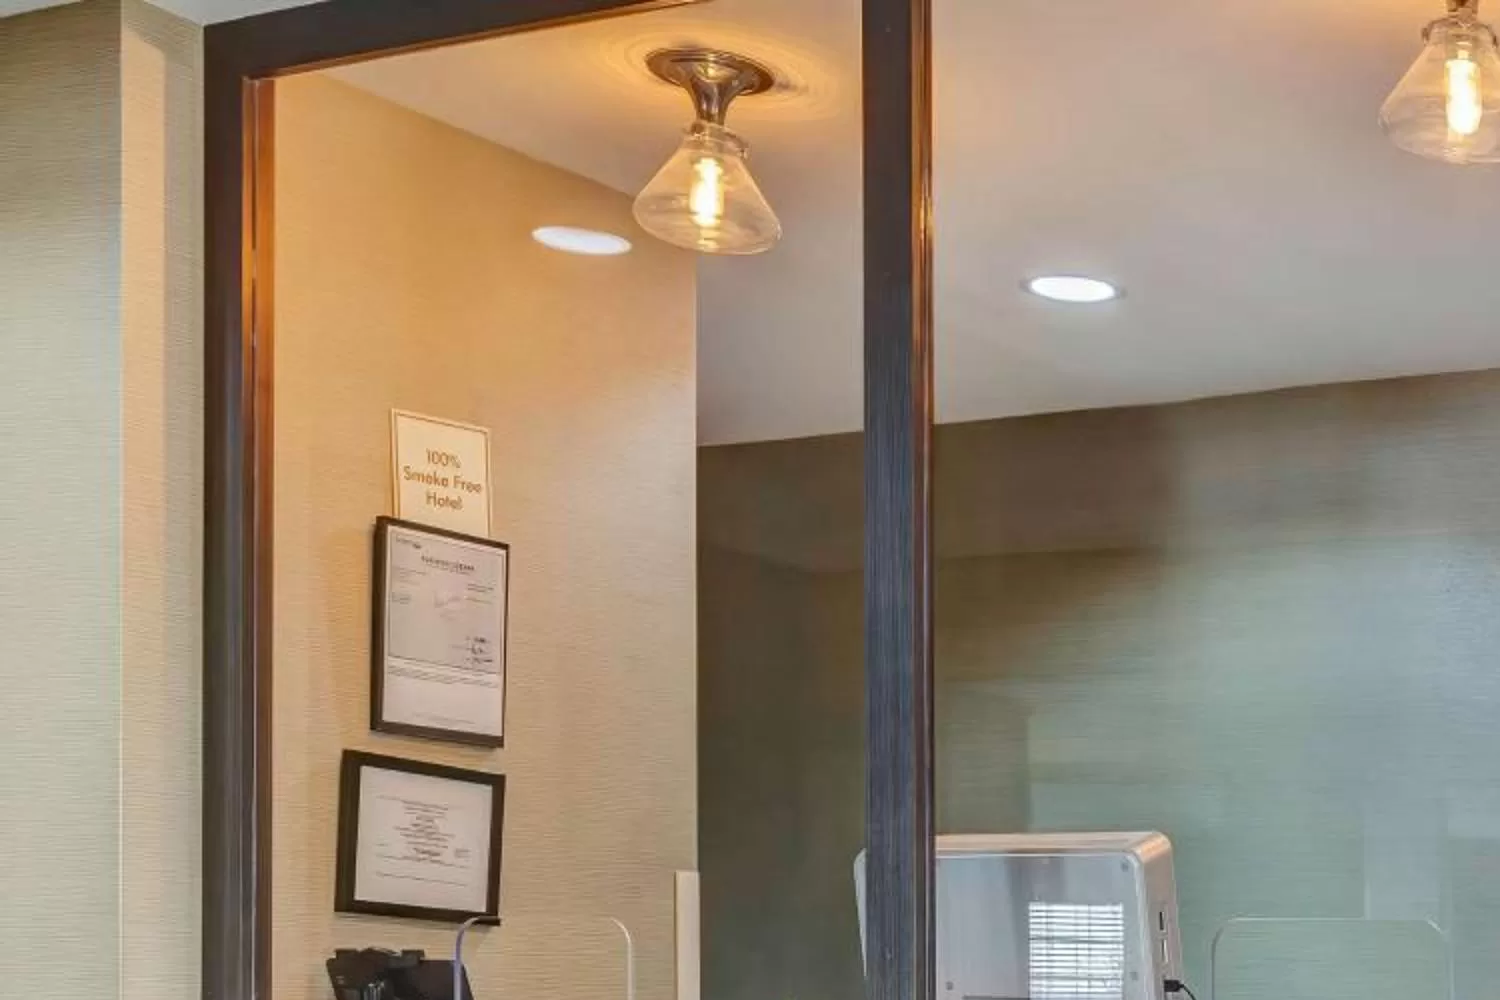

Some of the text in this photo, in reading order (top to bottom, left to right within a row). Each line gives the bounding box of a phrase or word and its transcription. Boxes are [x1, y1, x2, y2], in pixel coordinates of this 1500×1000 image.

[425, 448, 461, 469] 100%
[403, 465, 482, 493] Smoke Free
[425, 491, 463, 510] Hotel
